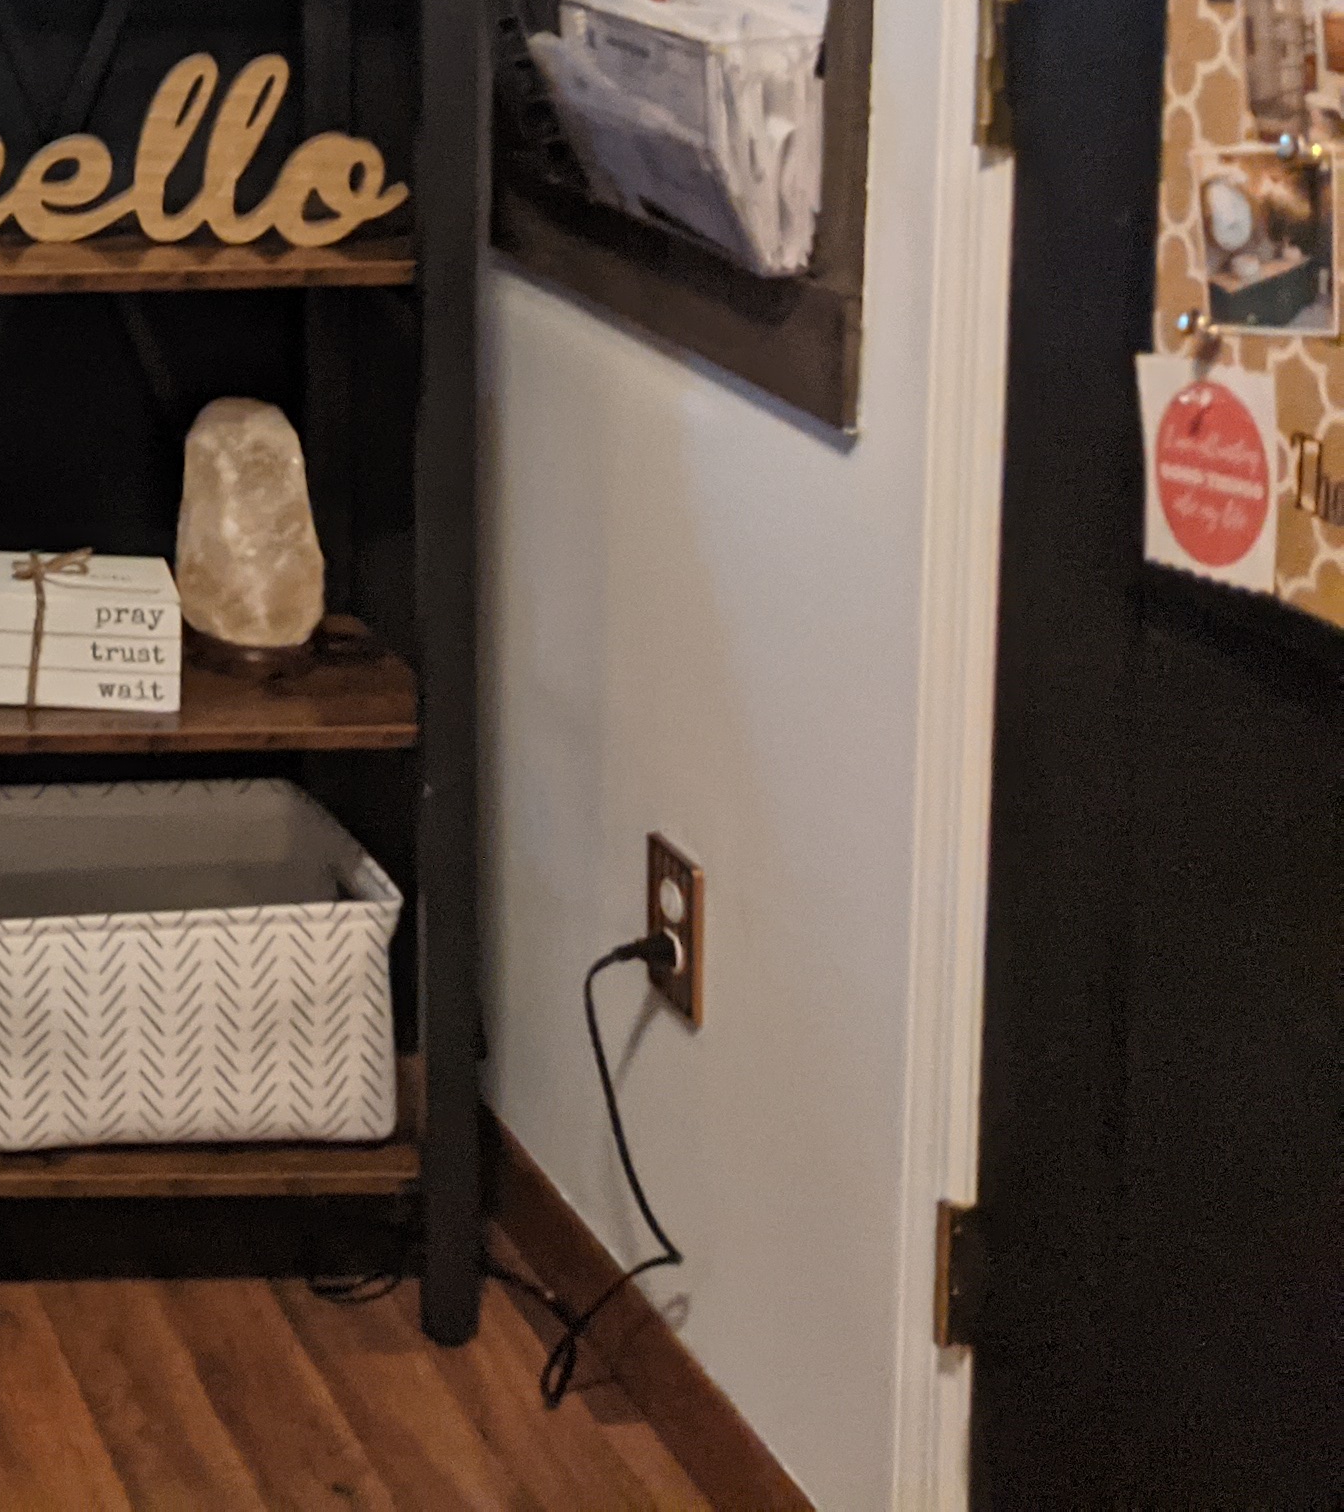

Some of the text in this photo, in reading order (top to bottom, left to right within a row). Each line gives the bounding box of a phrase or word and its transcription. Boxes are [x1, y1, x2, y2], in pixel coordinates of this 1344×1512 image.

[95, 604, 165, 631] pray
[90, 641, 166, 664] trust
[98, 679, 166, 702] wait
